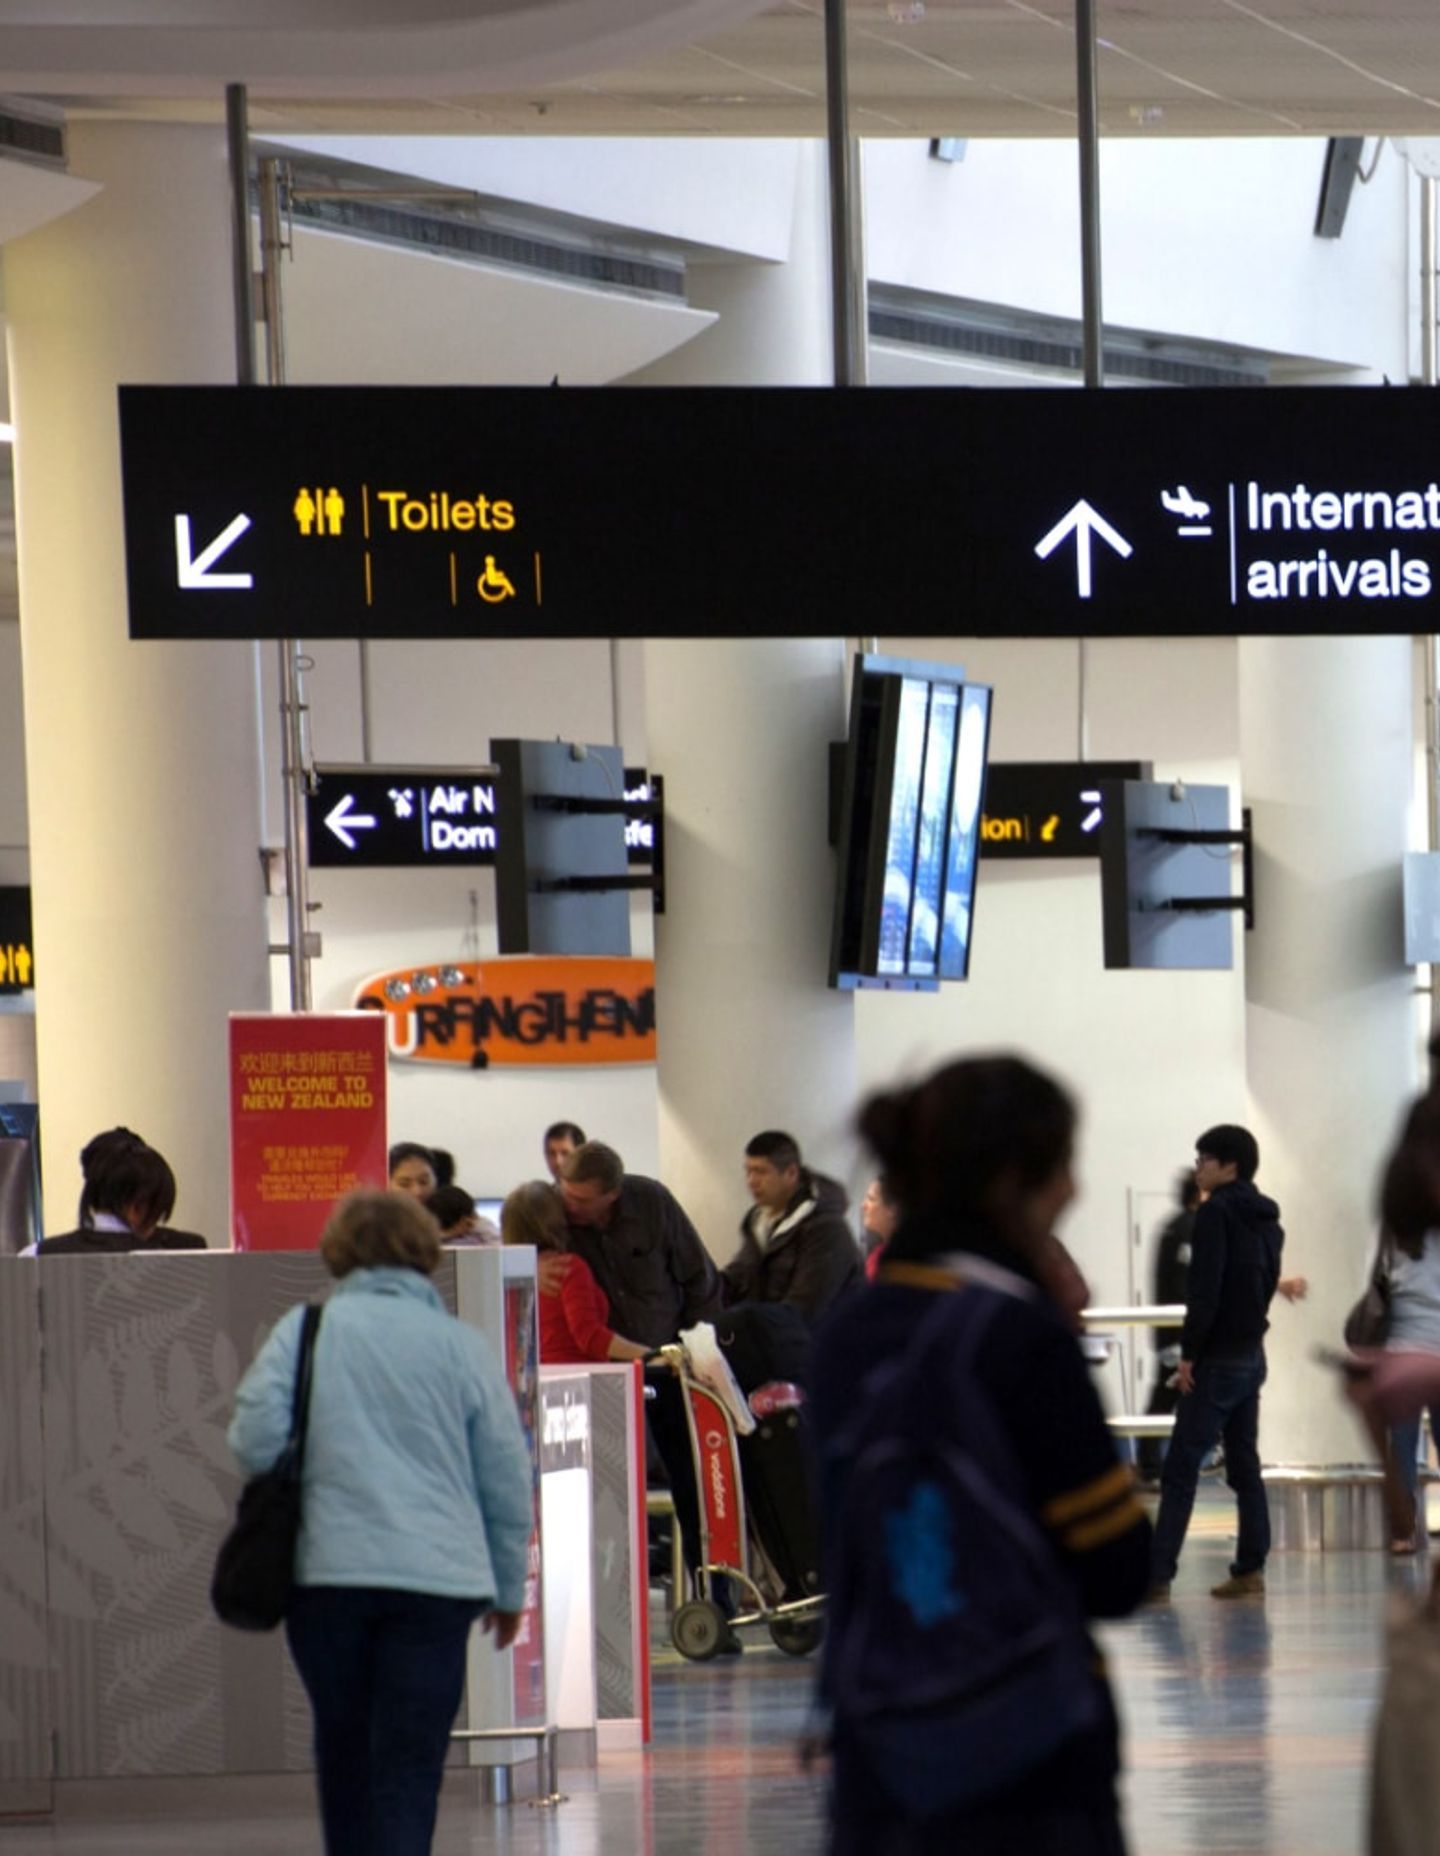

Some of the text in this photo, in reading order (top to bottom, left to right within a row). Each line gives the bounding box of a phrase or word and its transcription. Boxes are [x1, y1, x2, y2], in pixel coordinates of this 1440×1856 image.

[377, 491, 515, 531] Toilets
[1247, 548, 1432, 599] arrivals
[429, 784, 495, 815] Air N
[431, 820, 497, 850] Dom
[980, 812, 1022, 841] ion
[240, 1052, 374, 1074] 欢迎来到新西兰
[248, 1075, 367, 1093] WELCOME TO
[242, 1092, 373, 1111] NEW ZEALAND
[710, 1452, 726, 1519] vodafone
